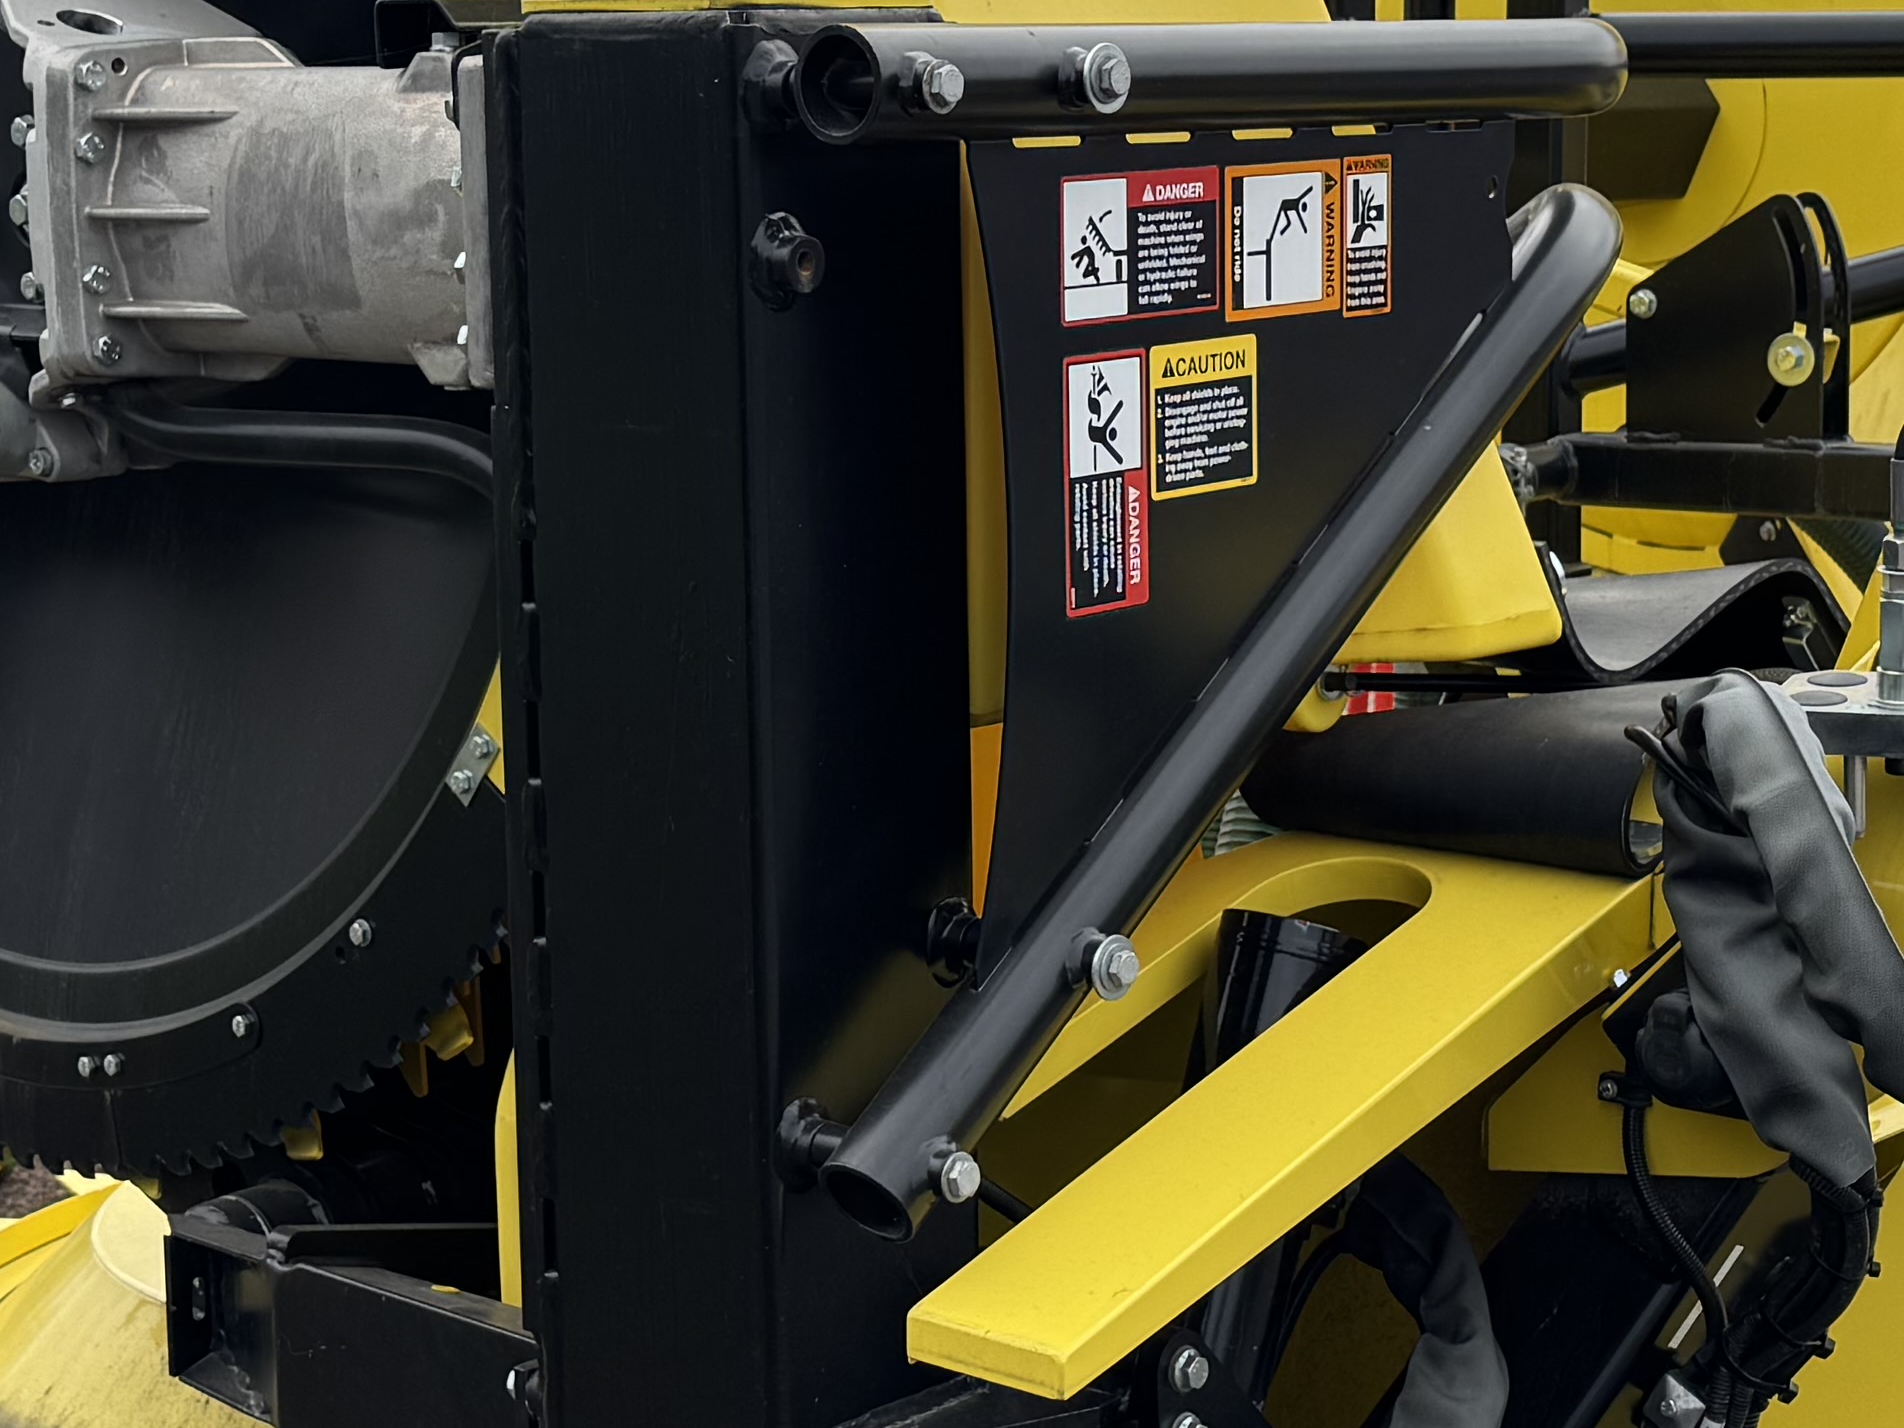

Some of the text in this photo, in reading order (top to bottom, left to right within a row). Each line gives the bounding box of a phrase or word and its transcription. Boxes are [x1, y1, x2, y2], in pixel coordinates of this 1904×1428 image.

[1156, 182, 1204, 201] DANGER
[1234, 206, 1242, 282] Do not ride
[1325, 202, 1335, 297] WARNING
[1175, 349, 1246, 377] CAUTION
[1129, 502, 1140, 584] DANGER
